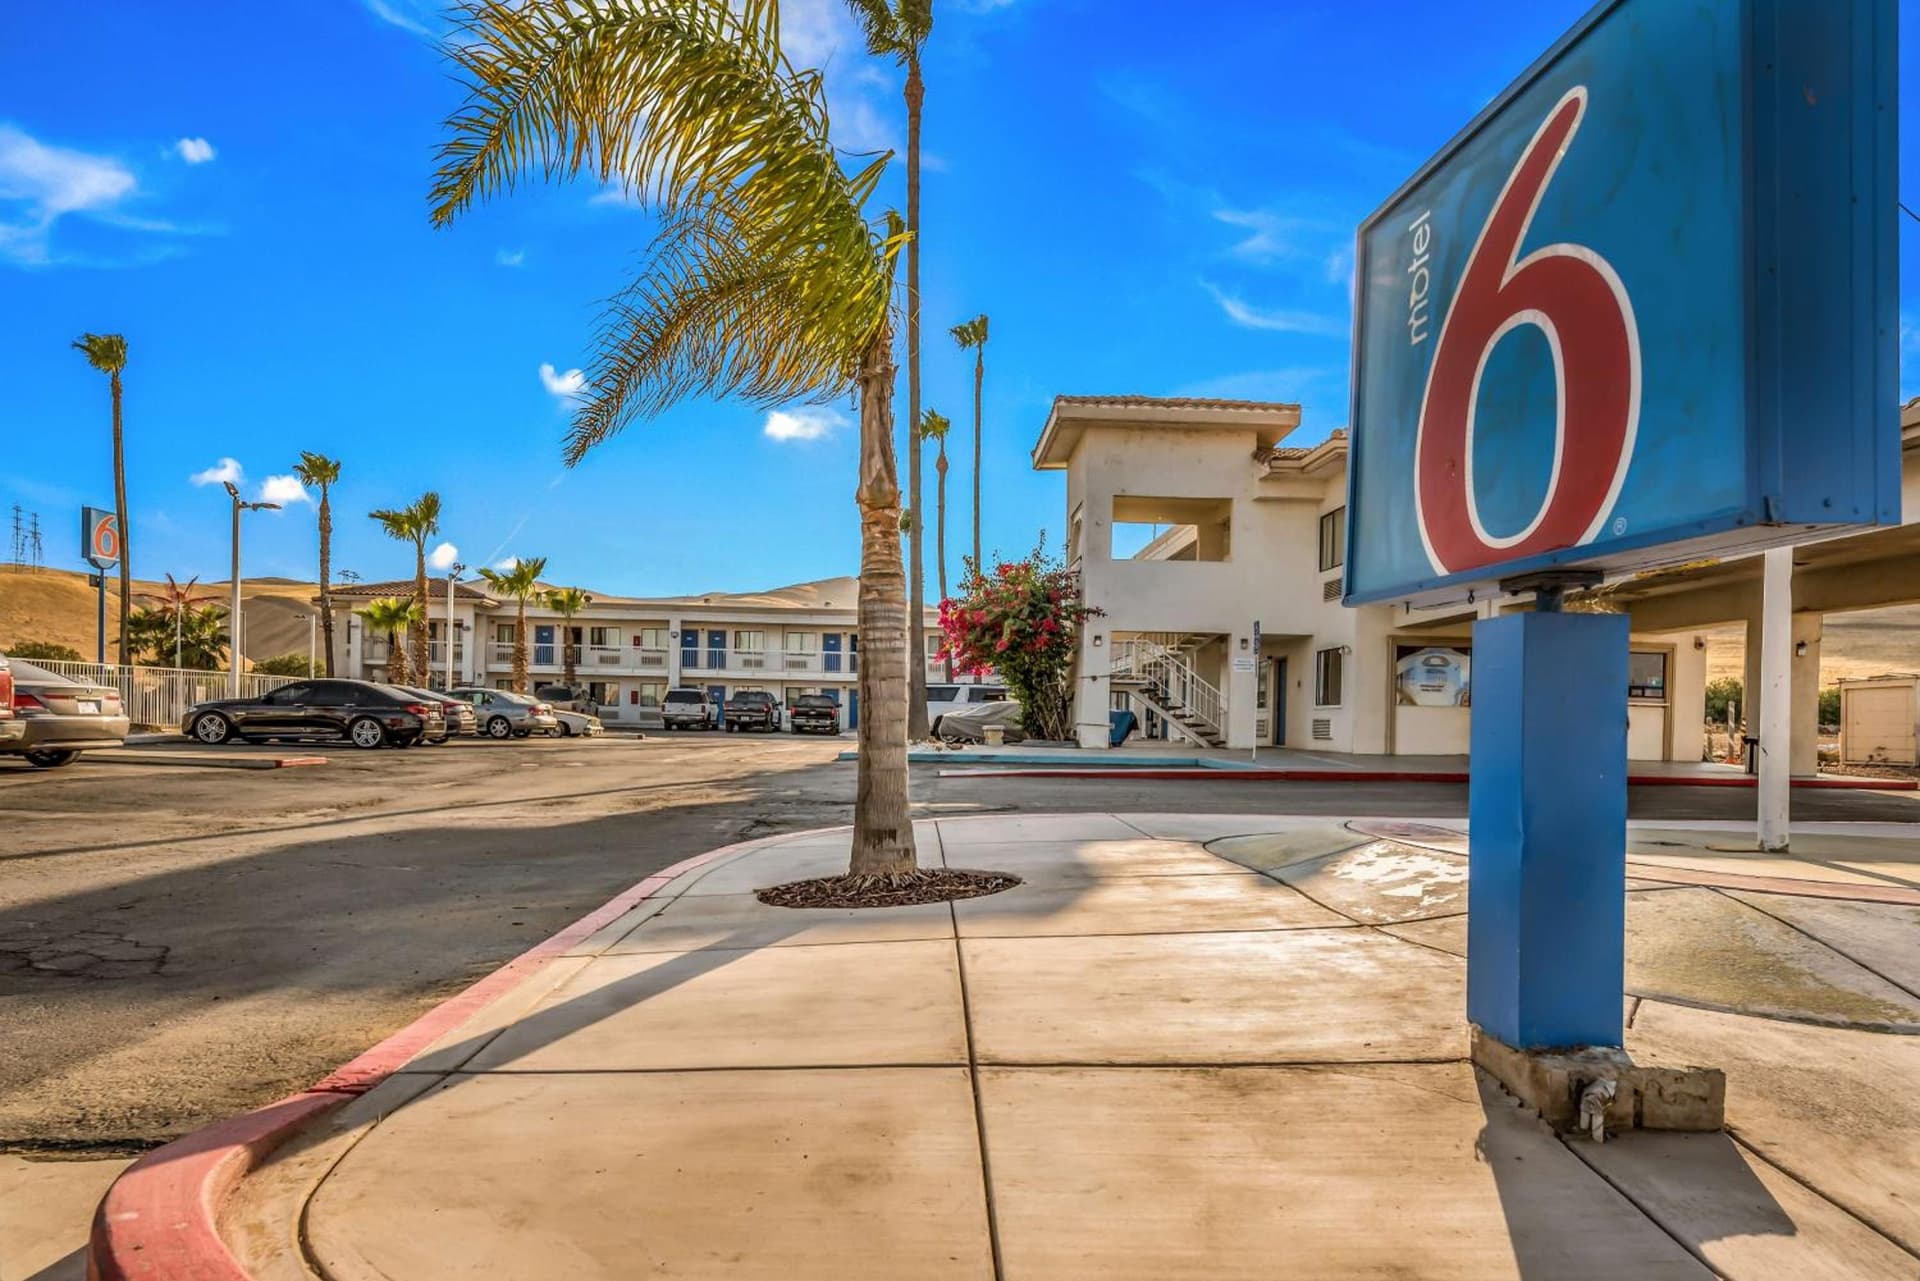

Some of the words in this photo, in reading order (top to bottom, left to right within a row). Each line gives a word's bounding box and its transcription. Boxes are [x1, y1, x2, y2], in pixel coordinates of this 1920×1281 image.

[1407, 210, 1431, 346] motel
[1414, 85, 1642, 577] 6
[94, 514, 120, 560] 6
